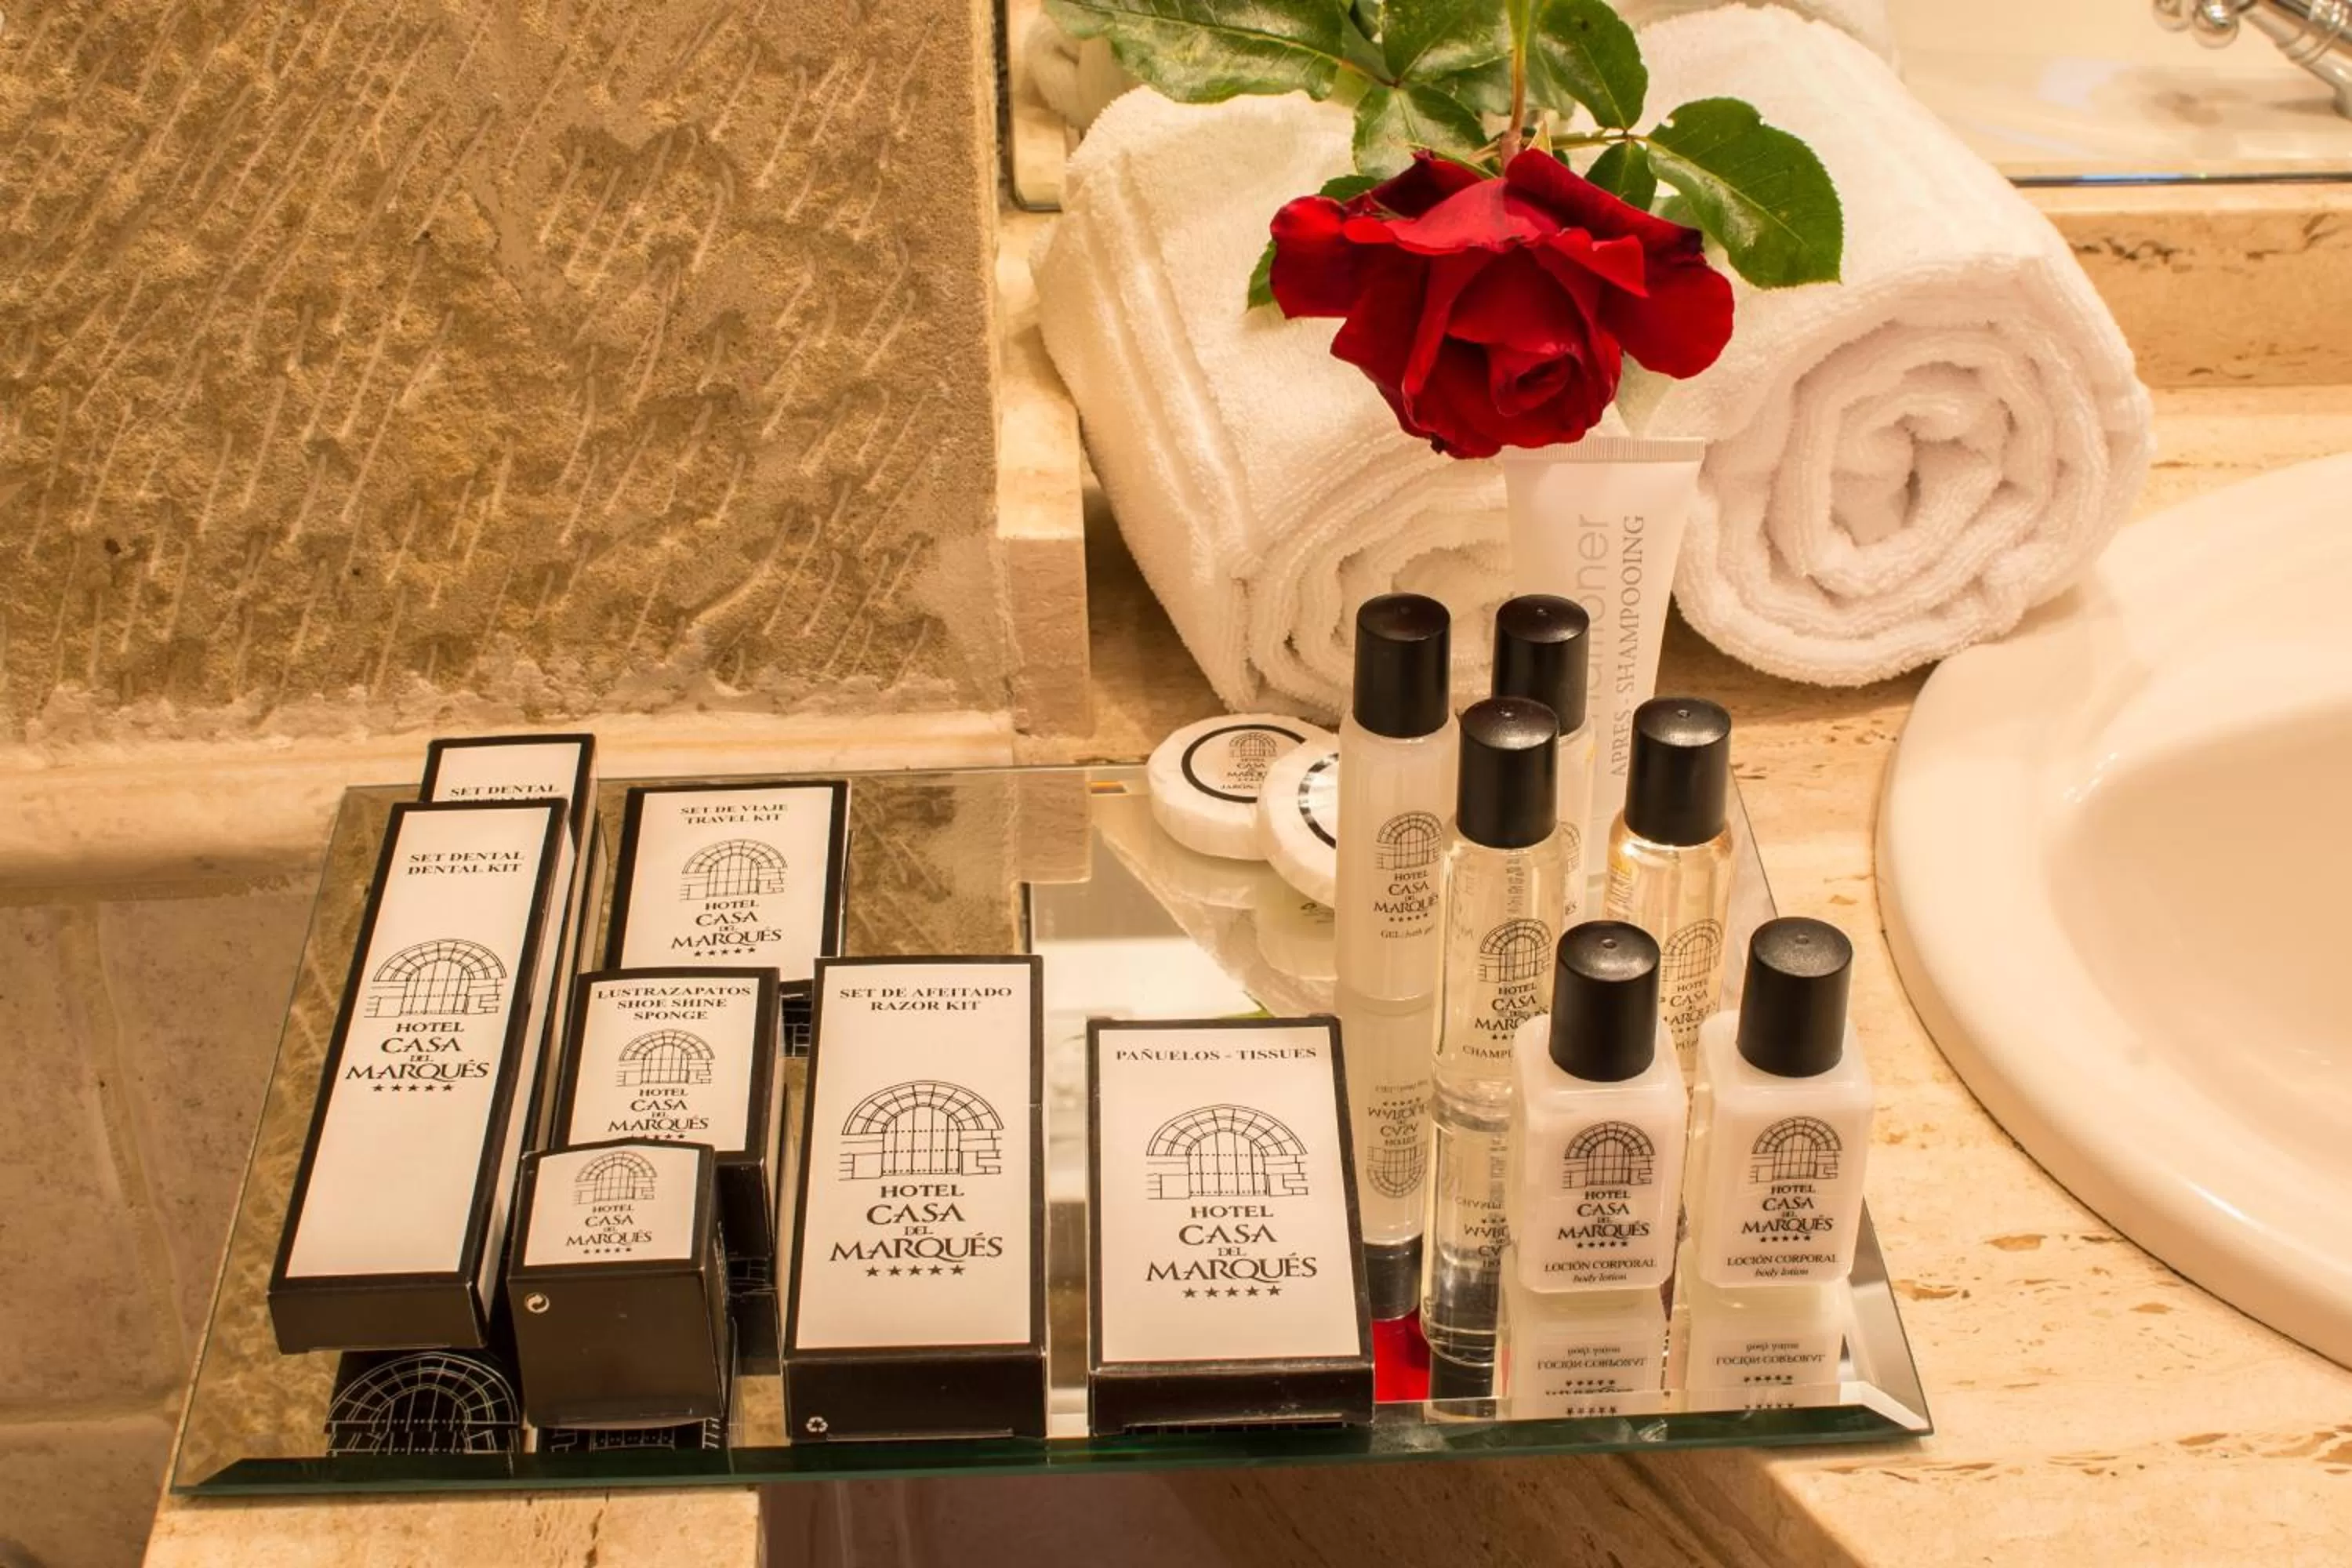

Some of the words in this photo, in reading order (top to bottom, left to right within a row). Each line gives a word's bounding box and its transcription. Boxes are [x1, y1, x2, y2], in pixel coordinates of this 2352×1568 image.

[1616, 514, 1645, 695] SHAMPOOING
[449, 785, 482, 797] SET
[488, 784, 561, 795] DENTAL
[680, 806, 711, 815] SET
[741, 804, 788, 812] VIAJE
[684, 815, 750, 824] TRAVEL
[409, 852, 446, 863] SET
[448, 851, 525, 862] DENTAL
[407, 864, 484, 876] DENTAL
[488, 862, 523, 873] KIT
[1394, 869, 1429, 881] HOTEL
[1388, 880, 1430, 896] CASA
[705, 899, 759, 910] HOTEL
[695, 911, 758, 927] CASA
[671, 927, 782, 949] MARQUÉS
[597, 986, 752, 1000] LUSTRAZAPATOS
[840, 987, 877, 998] SET
[881, 987, 907, 998] DE
[911, 986, 1013, 998] AFEITADO
[1498, 982, 1537, 995] HOTEL
[617, 999, 666, 1010] SHOE
[671, 998, 728, 1008] SHINE
[871, 1000, 939, 1011] RAZOR
[946, 1000, 982, 1011] KIT
[1491, 993, 1537, 1011] CASA
[633, 1010, 709, 1020] SPONGE
[395, 1022, 465, 1033] HOTEL
[380, 1036, 463, 1054] CASA
[409, 1054, 434, 1062] DEL
[1116, 1048, 1221, 1061] PAÑUELOS
[1236, 1047, 1317, 1059] TISSUES
[345, 1059, 491, 1083] MARQUÉS
[639, 1087, 689, 1097] HOTEL
[630, 1098, 688, 1112] CASA
[880, 1184, 965, 1198] HOTEL
[1584, 1189, 1632, 1200] HOTEL
[1771, 1184, 1816, 1195] HOTEL
[593, 1203, 634, 1213] HOTEL
[1577, 1202, 1630, 1218] CASA
[1762, 1196, 1815, 1211] CASA
[866, 1202, 966, 1225] CASA
[1191, 1205, 1274, 1218] HOTEL
[584, 1214, 634, 1228] CASA
[904, 1225, 934, 1236] DEL
[1178, 1223, 1278, 1246] CASA
[1557, 1220, 1650, 1240] MARQUÉS
[829, 1232, 1004, 1263] MARQUÉS
[1218, 1247, 1247, 1257] DEL
[1592, 1258, 1657, 1269] CORPORAL
[1774, 1254, 1838, 1264] CORPORAL
[1145, 1252, 1318, 1283] MARQUÉS
[1755, 1268, 1778, 1279] body
[1780, 1267, 1809, 1276] lotion
[1573, 1273, 1597, 1283] body
[1599, 1272, 1627, 1281] lotion
